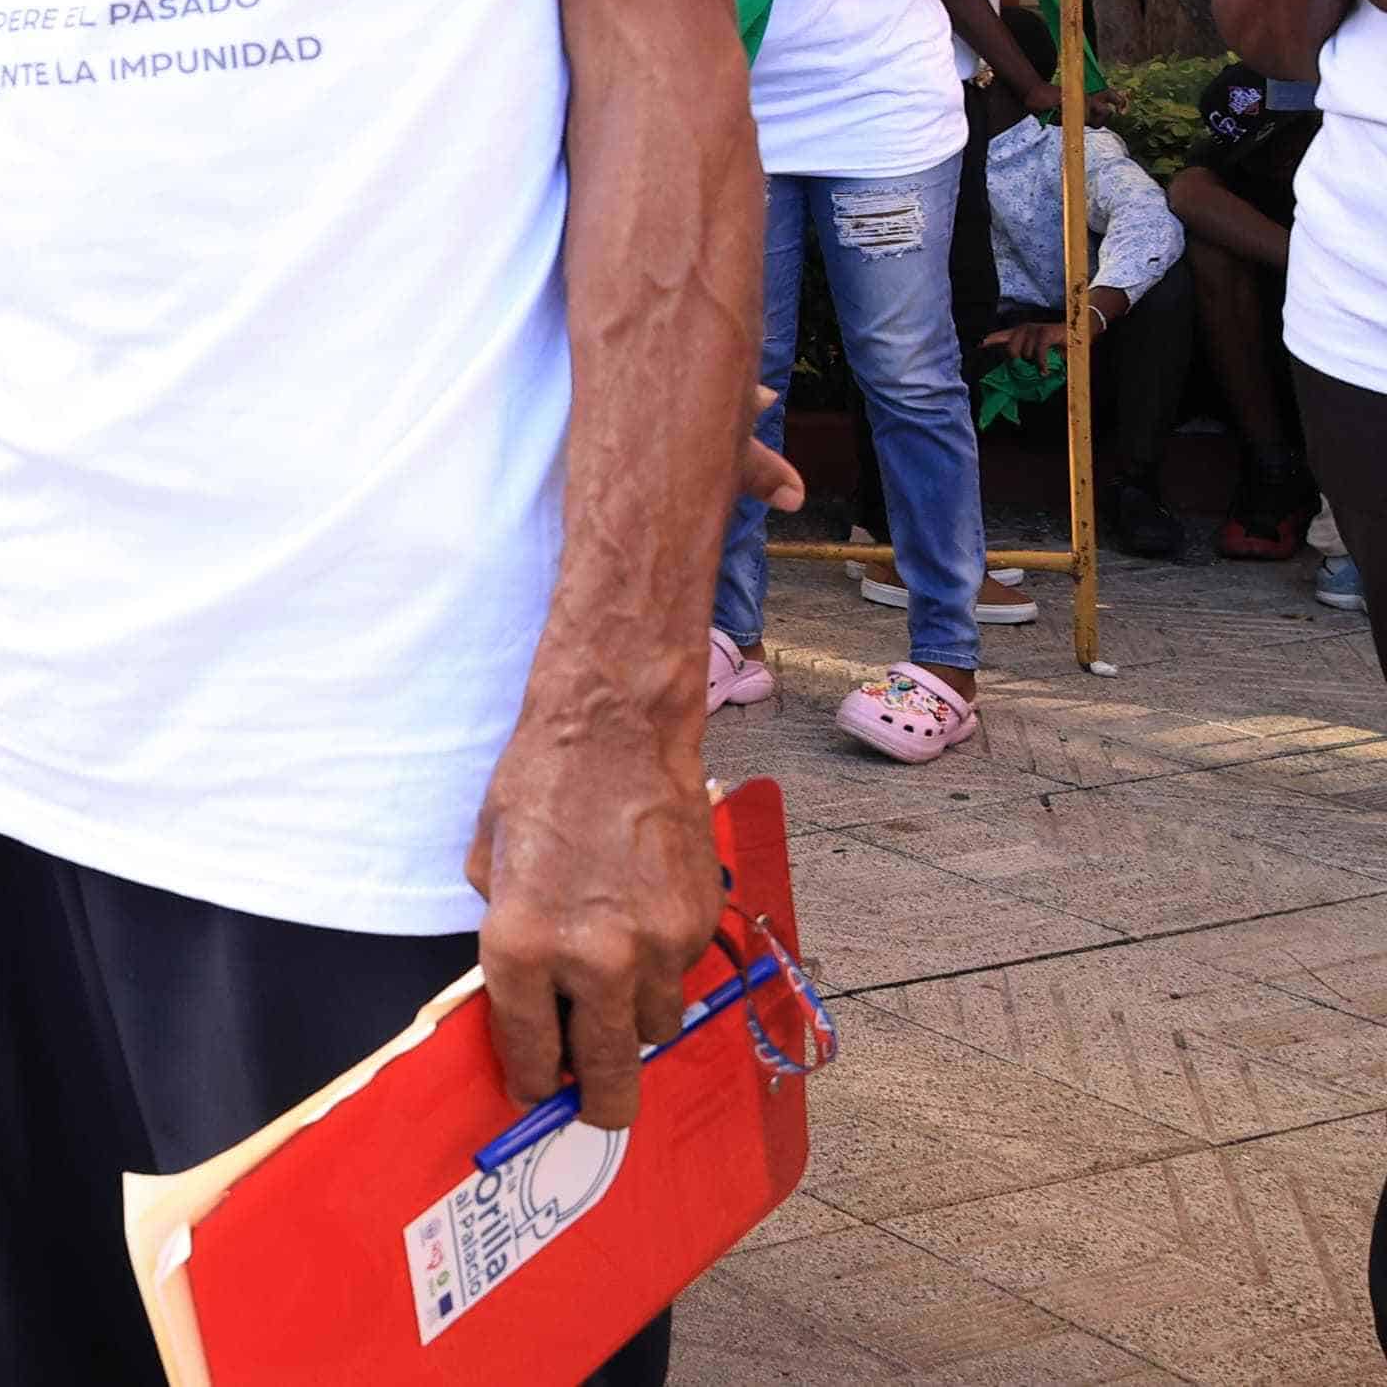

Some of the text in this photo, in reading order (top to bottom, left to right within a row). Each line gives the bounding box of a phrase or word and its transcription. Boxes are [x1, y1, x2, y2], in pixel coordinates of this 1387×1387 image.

[56, 58, 97, 84] LA
[110, 35, 323, 81] IMPUNIDAD
[456, 1189, 482, 1296] al Palacio
[476, 1169, 512, 1284] Orilla
